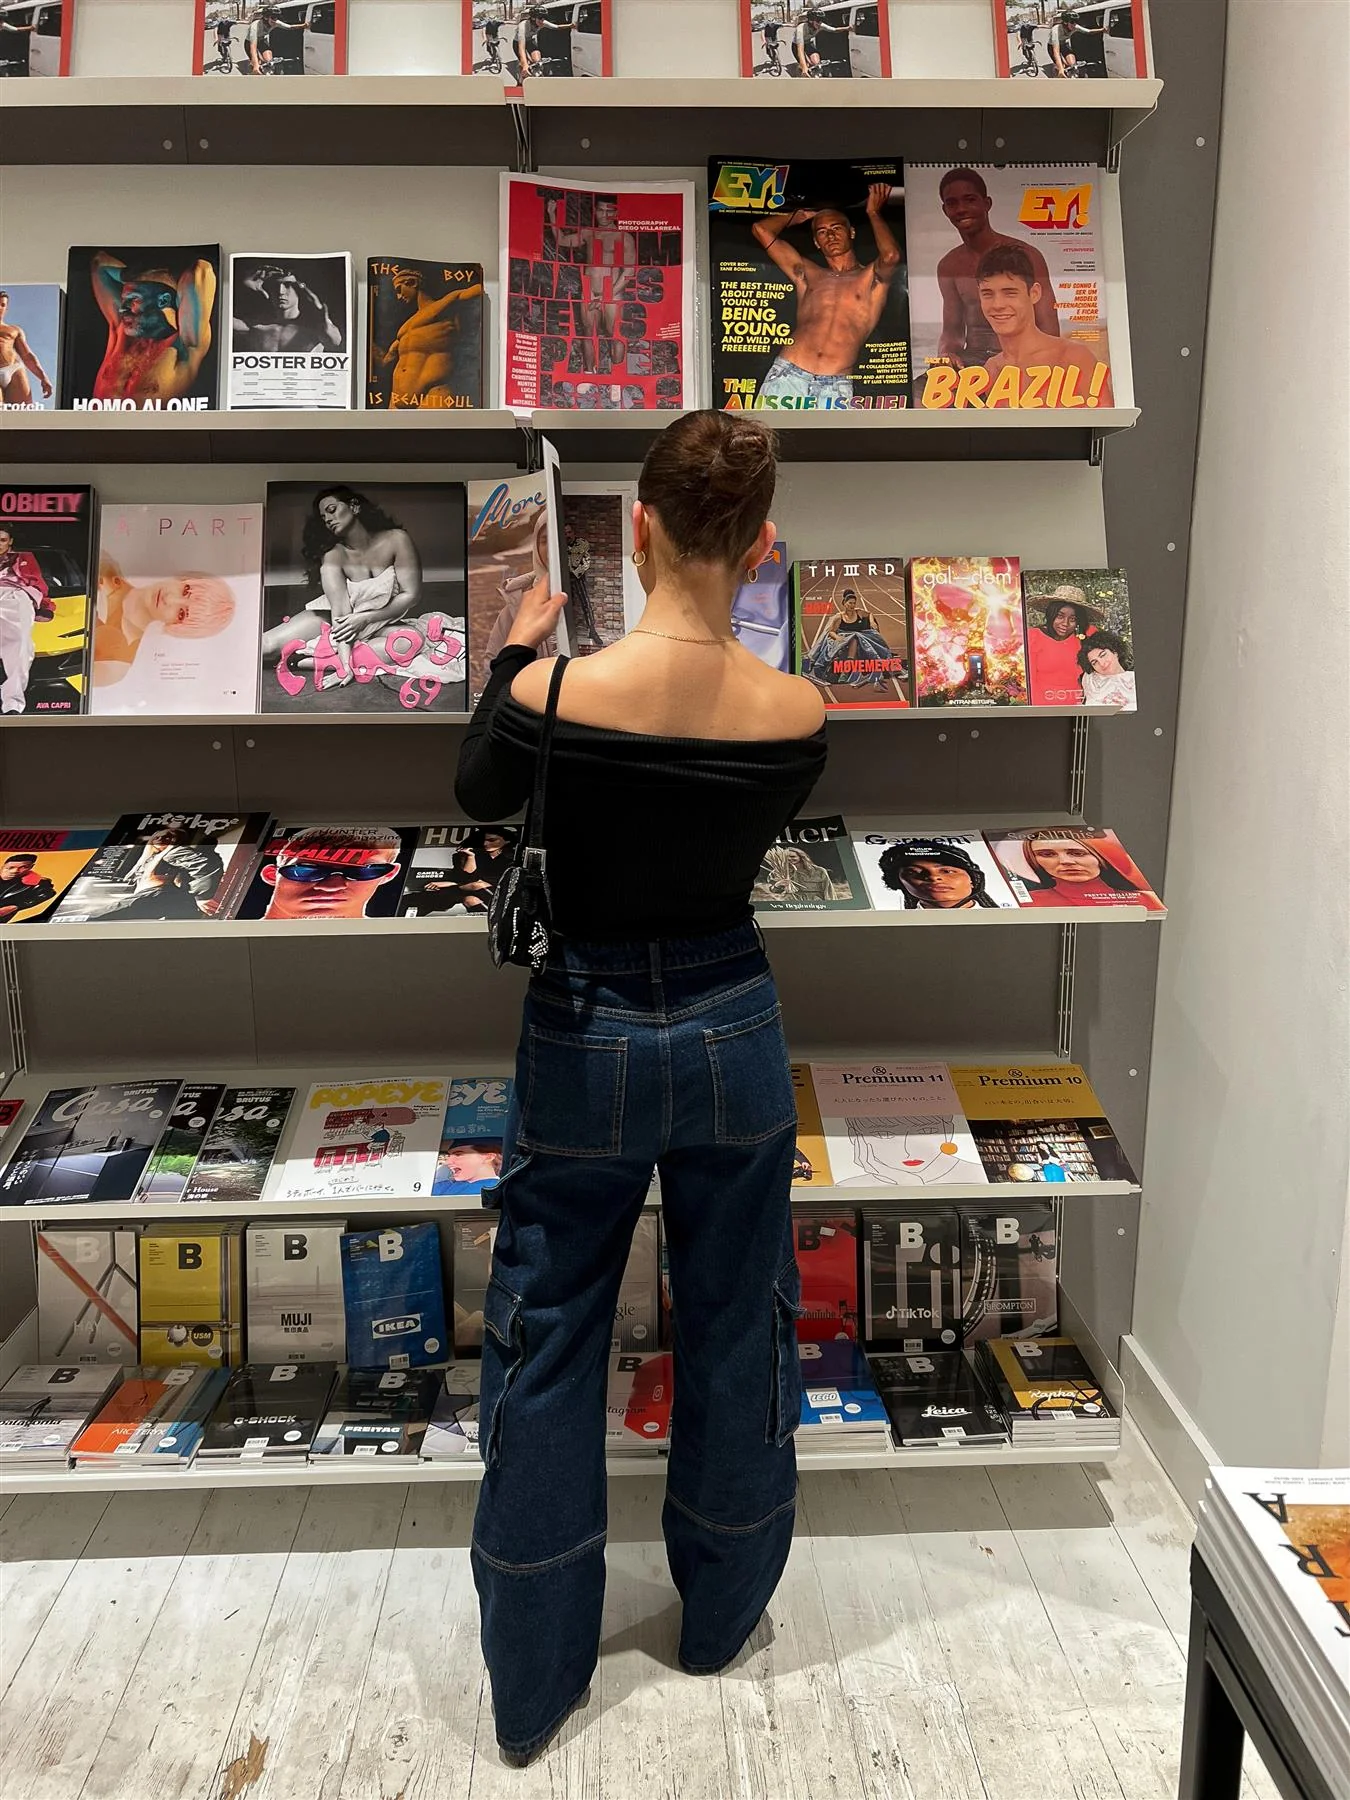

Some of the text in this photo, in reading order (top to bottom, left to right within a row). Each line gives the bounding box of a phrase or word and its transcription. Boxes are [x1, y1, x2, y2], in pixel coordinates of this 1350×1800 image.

[713, 165, 790, 209] EY!
[1017, 182, 1094, 230] EY!
[371, 263, 400, 276] THE
[444, 270, 474, 282] BOY
[740, 282, 762, 290] BEST
[763, 283, 794, 292] THING
[720, 290, 785, 300] ABOUT BEING
[721, 298, 757, 306] YOUNG
[721, 307, 777, 322] BEING
[722, 321, 790, 337] YOUNG
[746, 336, 770, 344] WILD
[772, 337, 794, 345] AND
[233, 356, 349, 369] POSTER BOY
[723, 378, 756, 393] THE
[921, 362, 1108, 409] BRAZIL!
[73, 397, 208, 411] HOMO ALONE
[369, 392, 383, 404] IS
[724, 393, 817, 410] AUSSIE
[471, 482, 547, 542] More
[399, 675, 443, 710] 69
[842, 1072, 925, 1085] Premium
[928, 1074, 944, 1082] 11
[978, 1074, 1082, 1087] Premium 10
[310, 1081, 444, 1110] POPEYE
[52, 1090, 155, 1122] Casa
[413, 1182, 421, 1192] 9
[798, 1224, 821, 1250] B
[900, 1222, 924, 1248] B
[996, 1217, 1020, 1244] B
[75, 1237, 100, 1262] B
[284, 1234, 308, 1260] B
[378, 1233, 404, 1262] B
[178, 1243, 202, 1270] B
[899, 1307, 941, 1318] TikTok
[985, 1301, 1034, 1312] BROMPTON
[281, 1313, 312, 1327] MUJI
[378, 1319, 416, 1333] IKEA
[193, 1332, 212, 1341] USM
[798, 1343, 823, 1360] B
[1014, 1341, 1043, 1357] B
[617, 1357, 642, 1372] B
[906, 1356, 935, 1373] B
[48, 1367, 80, 1384] B
[162, 1368, 195, 1385] B
[269, 1365, 299, 1382] B
[378, 1372, 408, 1389] B
[811, 1392, 837, 1402] LEGO
[1028, 1388, 1079, 1401] Rapha
[921, 1404, 973, 1418] Leica
[234, 1415, 297, 1425] G-SHOCK
[344, 1425, 401, 1434] FREITAG
